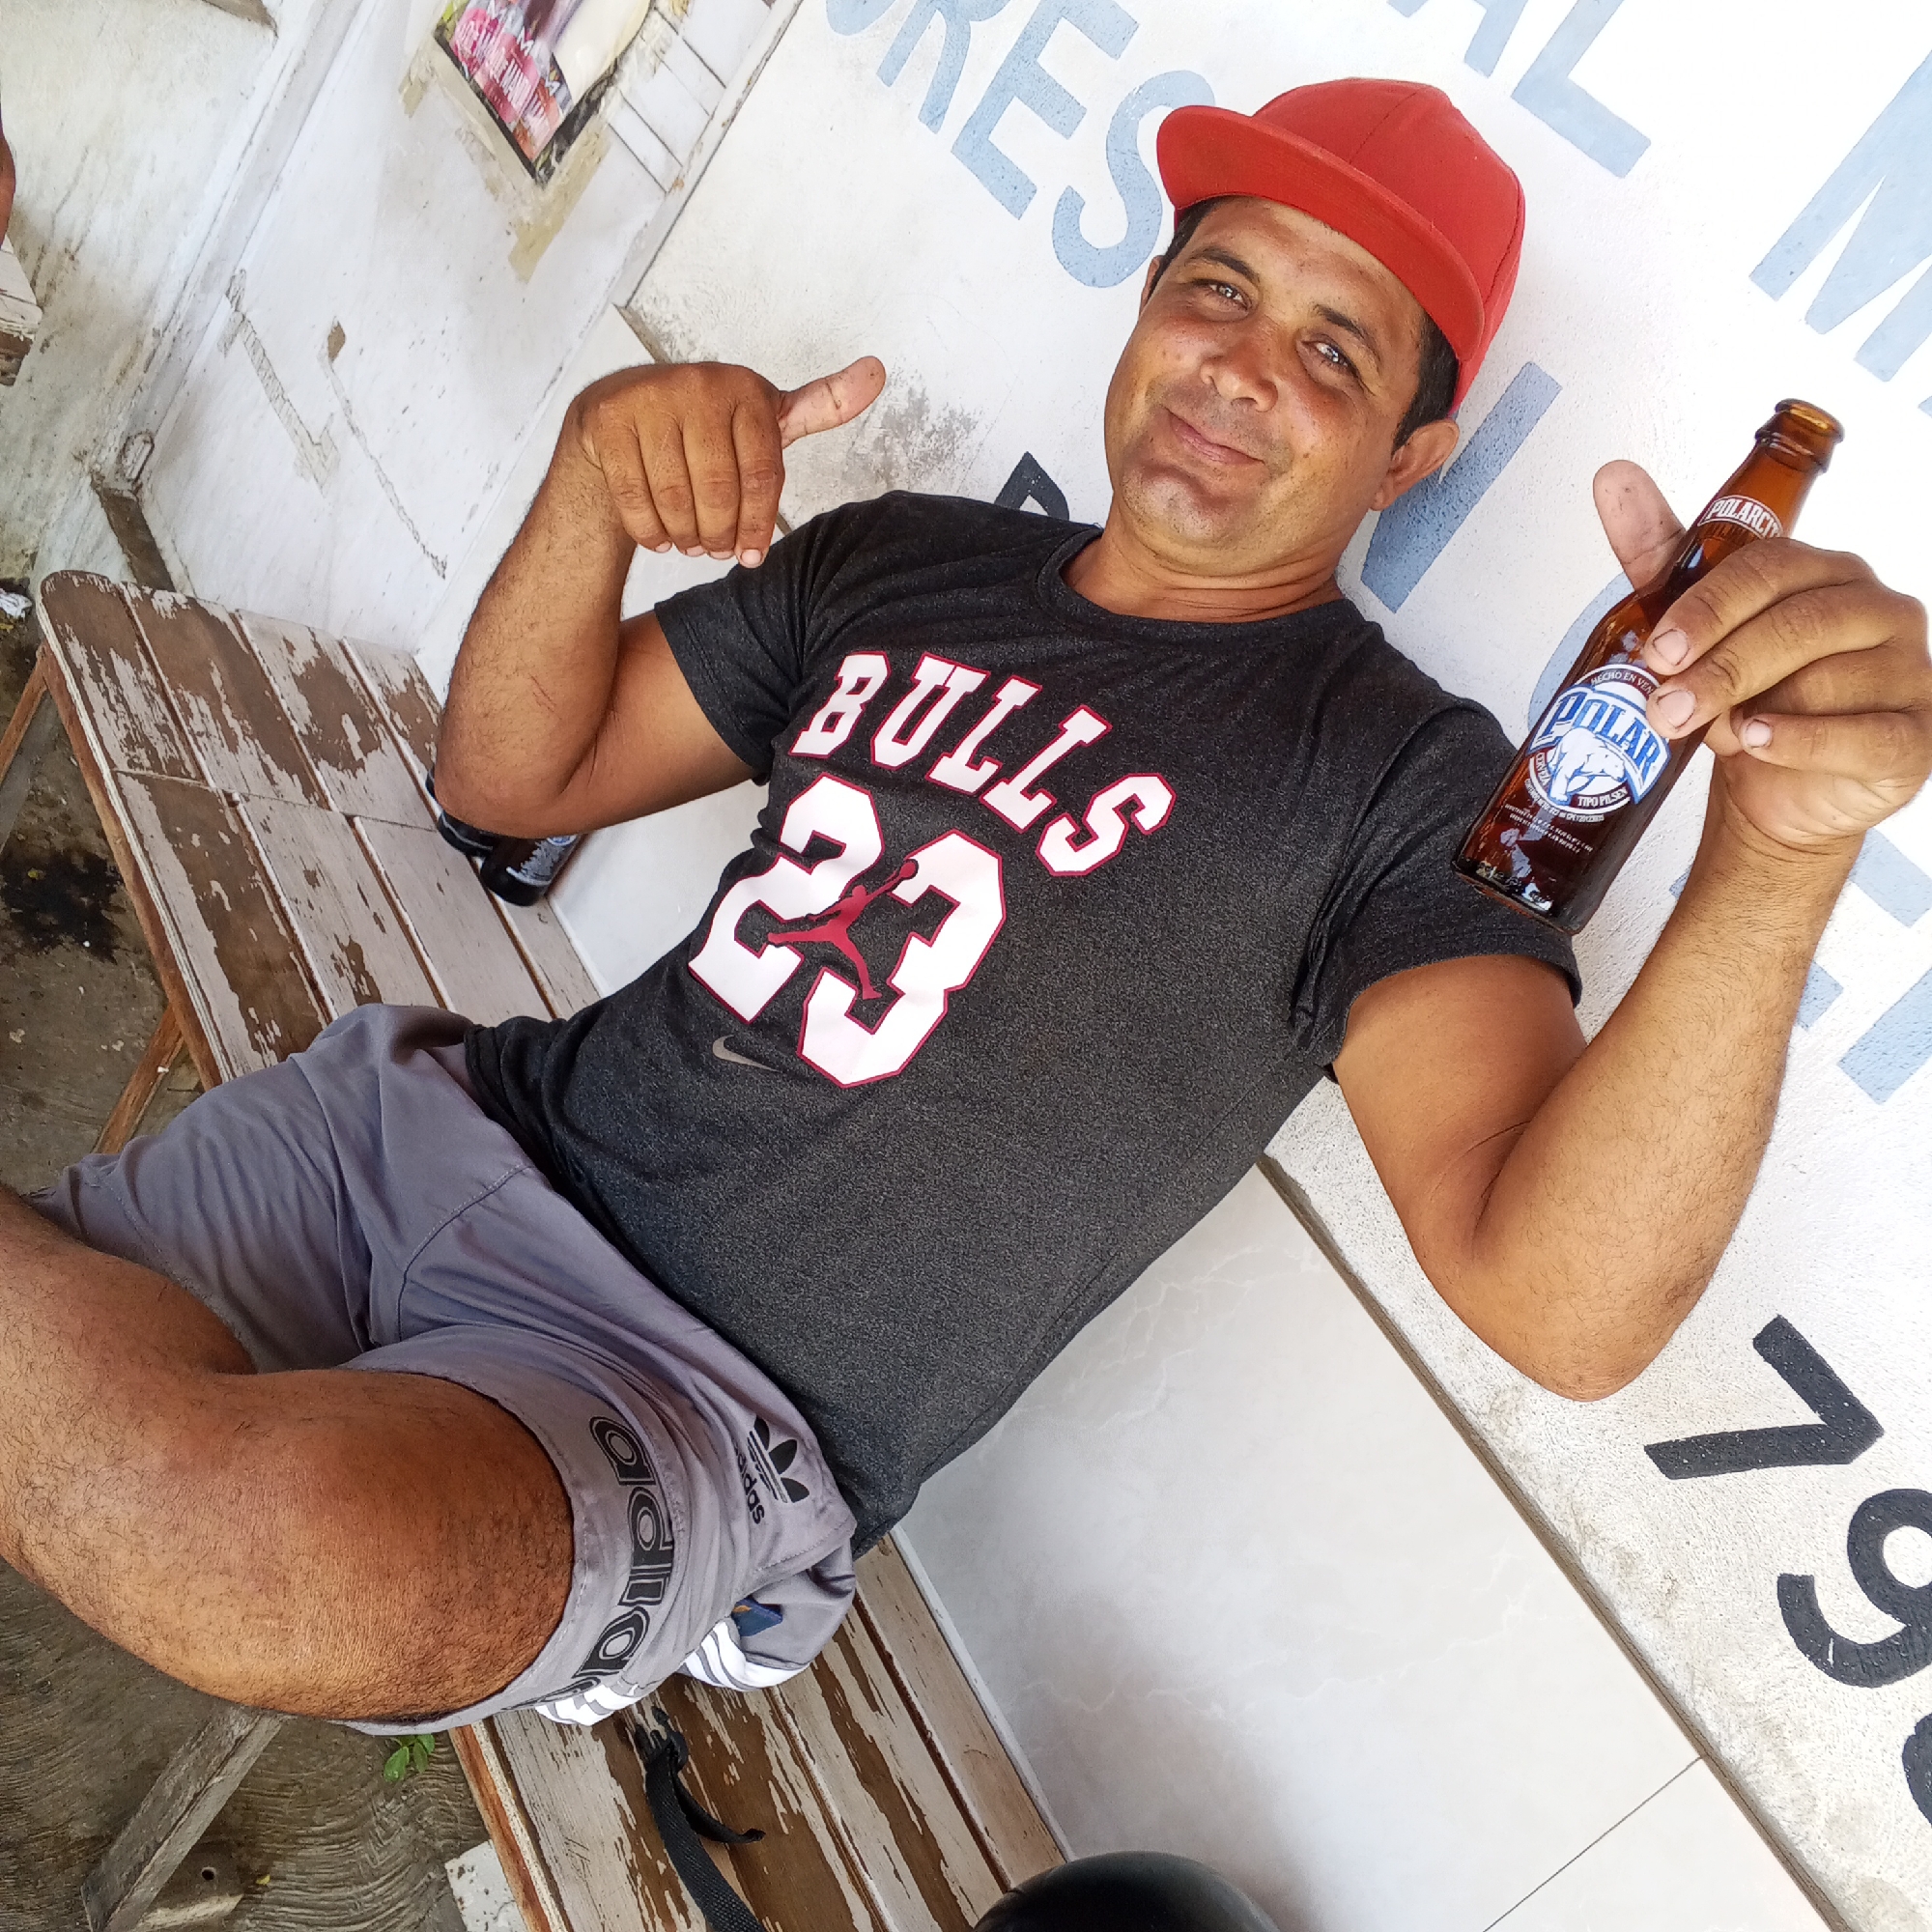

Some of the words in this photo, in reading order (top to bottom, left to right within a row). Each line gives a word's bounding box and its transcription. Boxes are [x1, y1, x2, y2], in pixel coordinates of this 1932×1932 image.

[825, 0, 1216, 289] RES
[1705, 497, 1783, 538] POLARCIT
[1590, 669, 1623, 686] HECHO
[1624, 670, 1636, 683] EN
[1637, 677, 1655, 695] VEN
[787, 650, 1177, 876] BULLS
[1537, 691, 1662, 783] POLAR
[1577, 795, 1599, 808] TIPO
[1599, 787, 1629, 806] PILSEN
[688, 773, 1007, 1088] 23
